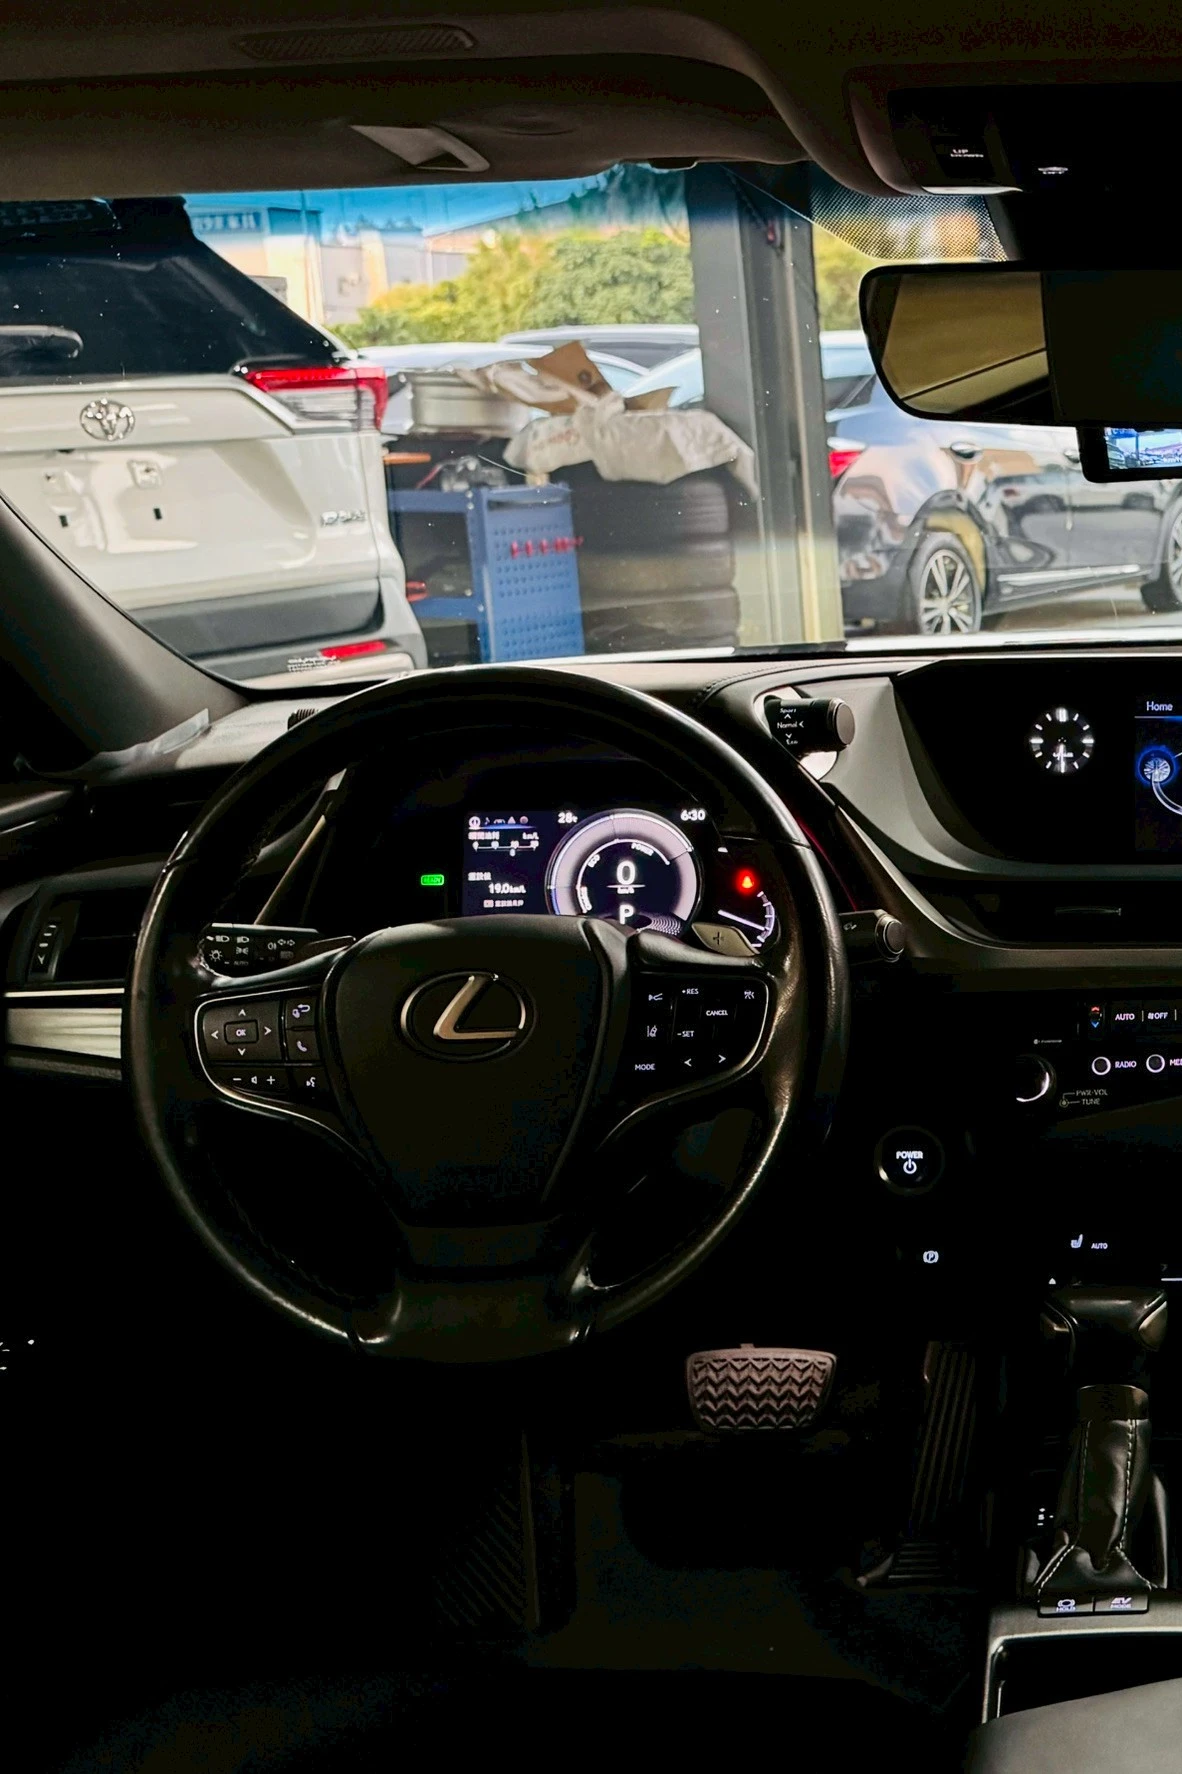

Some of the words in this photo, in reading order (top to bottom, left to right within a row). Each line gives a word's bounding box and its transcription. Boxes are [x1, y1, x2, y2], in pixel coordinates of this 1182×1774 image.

[1147, 701, 1173, 711] Home
[680, 809, 706, 821] 6:30
[615, 860, 636, 885] 0
[619, 903, 635, 924] P
[705, 1009, 729, 1017] CANCEL
[634, 1063, 656, 1071] MODE
[896, 1150, 924, 1159] POWER
[1090, 1242, 1109, 1250] AUTO
